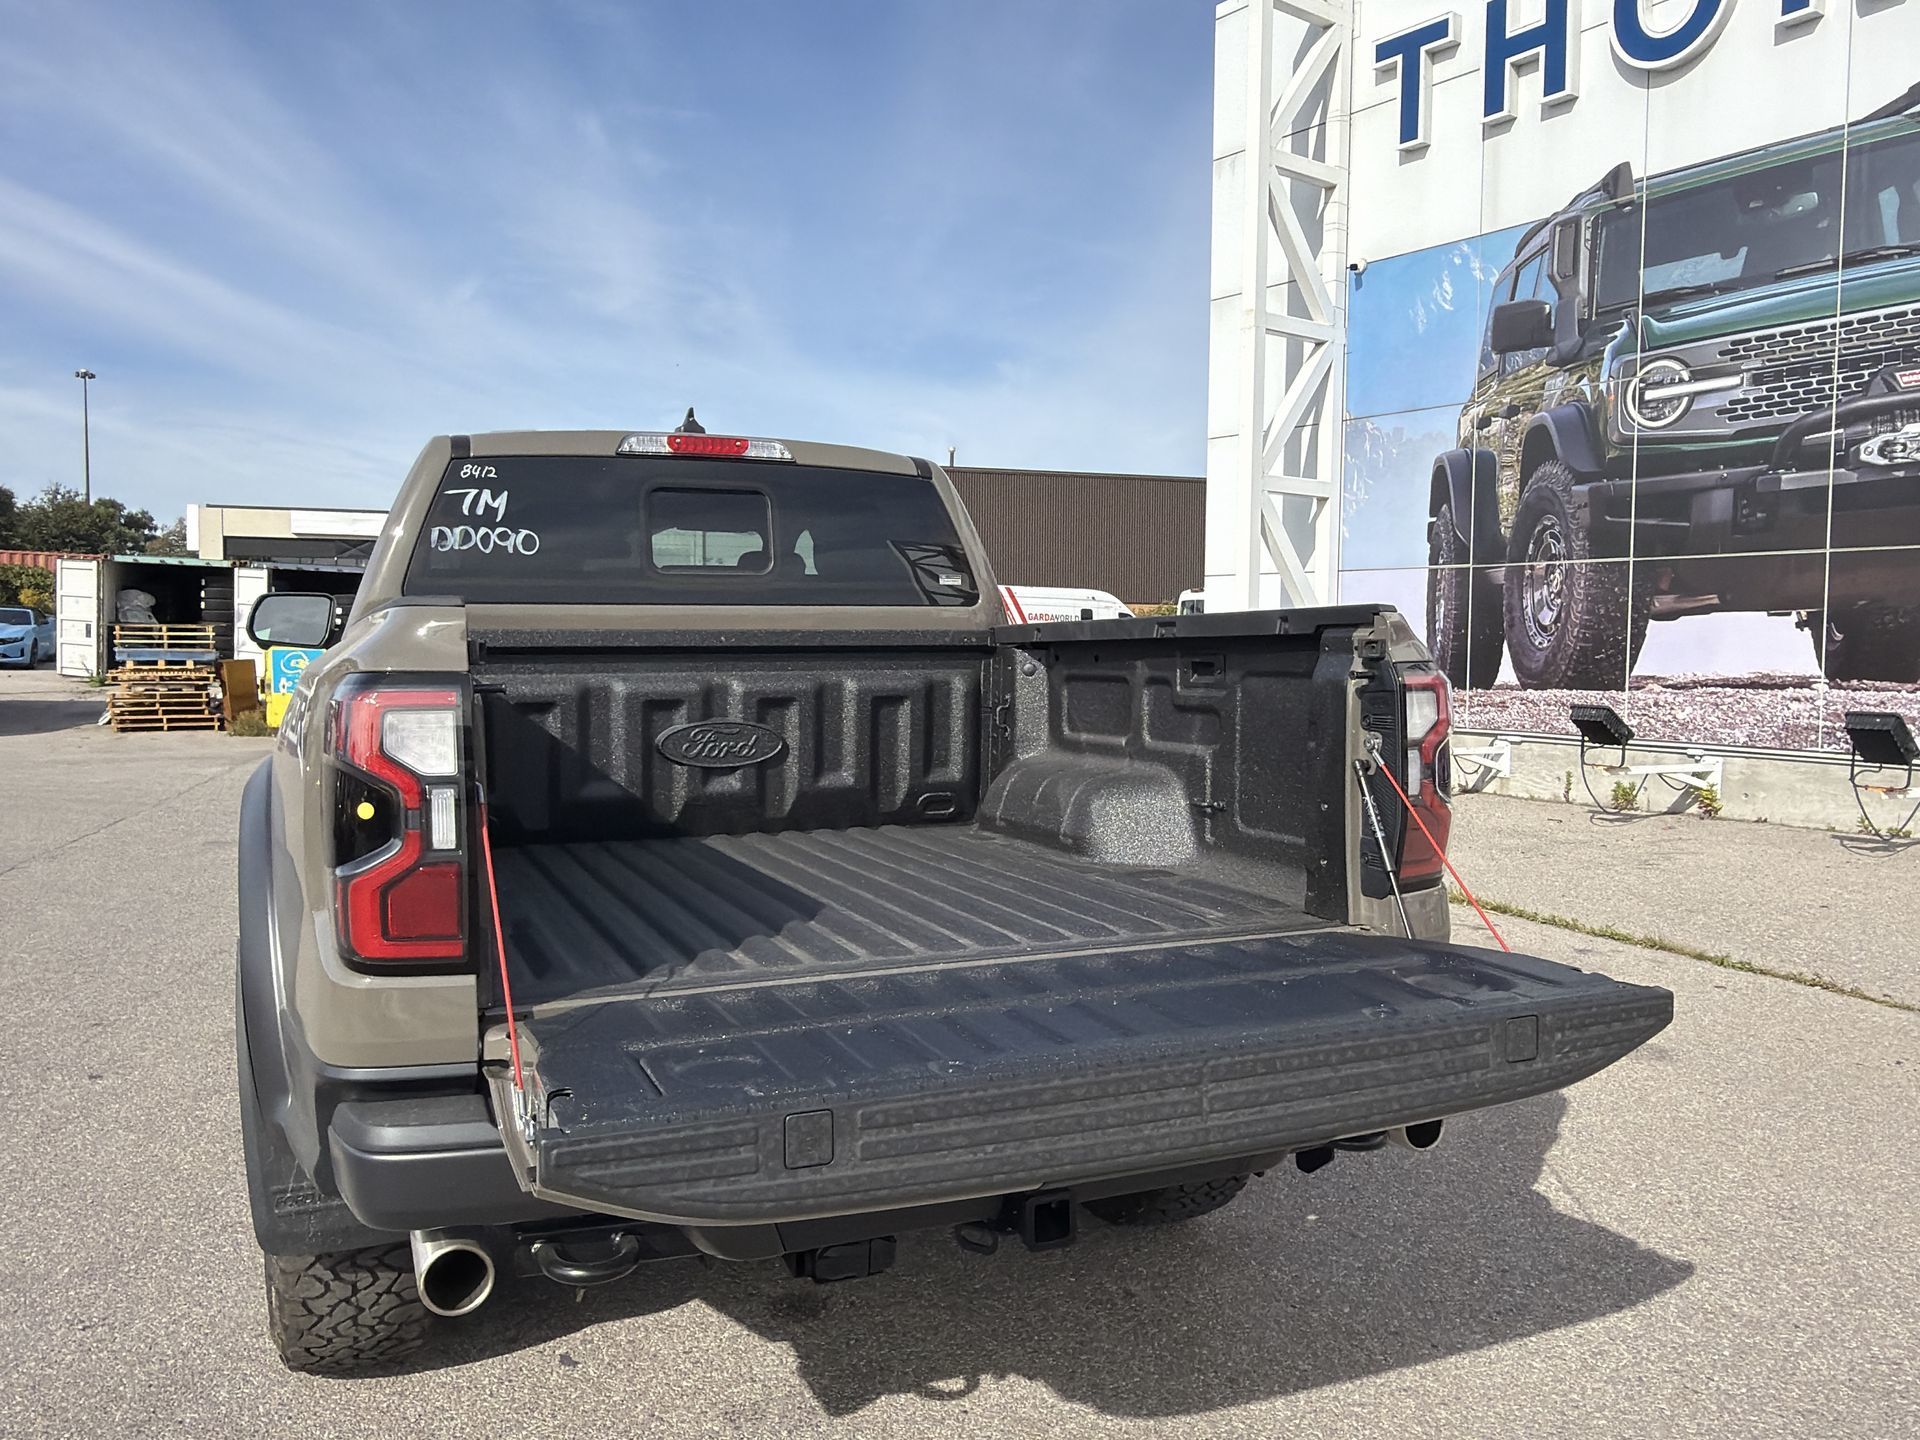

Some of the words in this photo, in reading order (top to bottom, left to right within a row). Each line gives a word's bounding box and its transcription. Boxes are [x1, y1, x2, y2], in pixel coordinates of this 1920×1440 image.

[1374, 0, 1825, 150] THO
[460, 464, 498, 479] 8412
[443, 488, 509, 523] 7M
[682, 727, 758, 758] Ford
